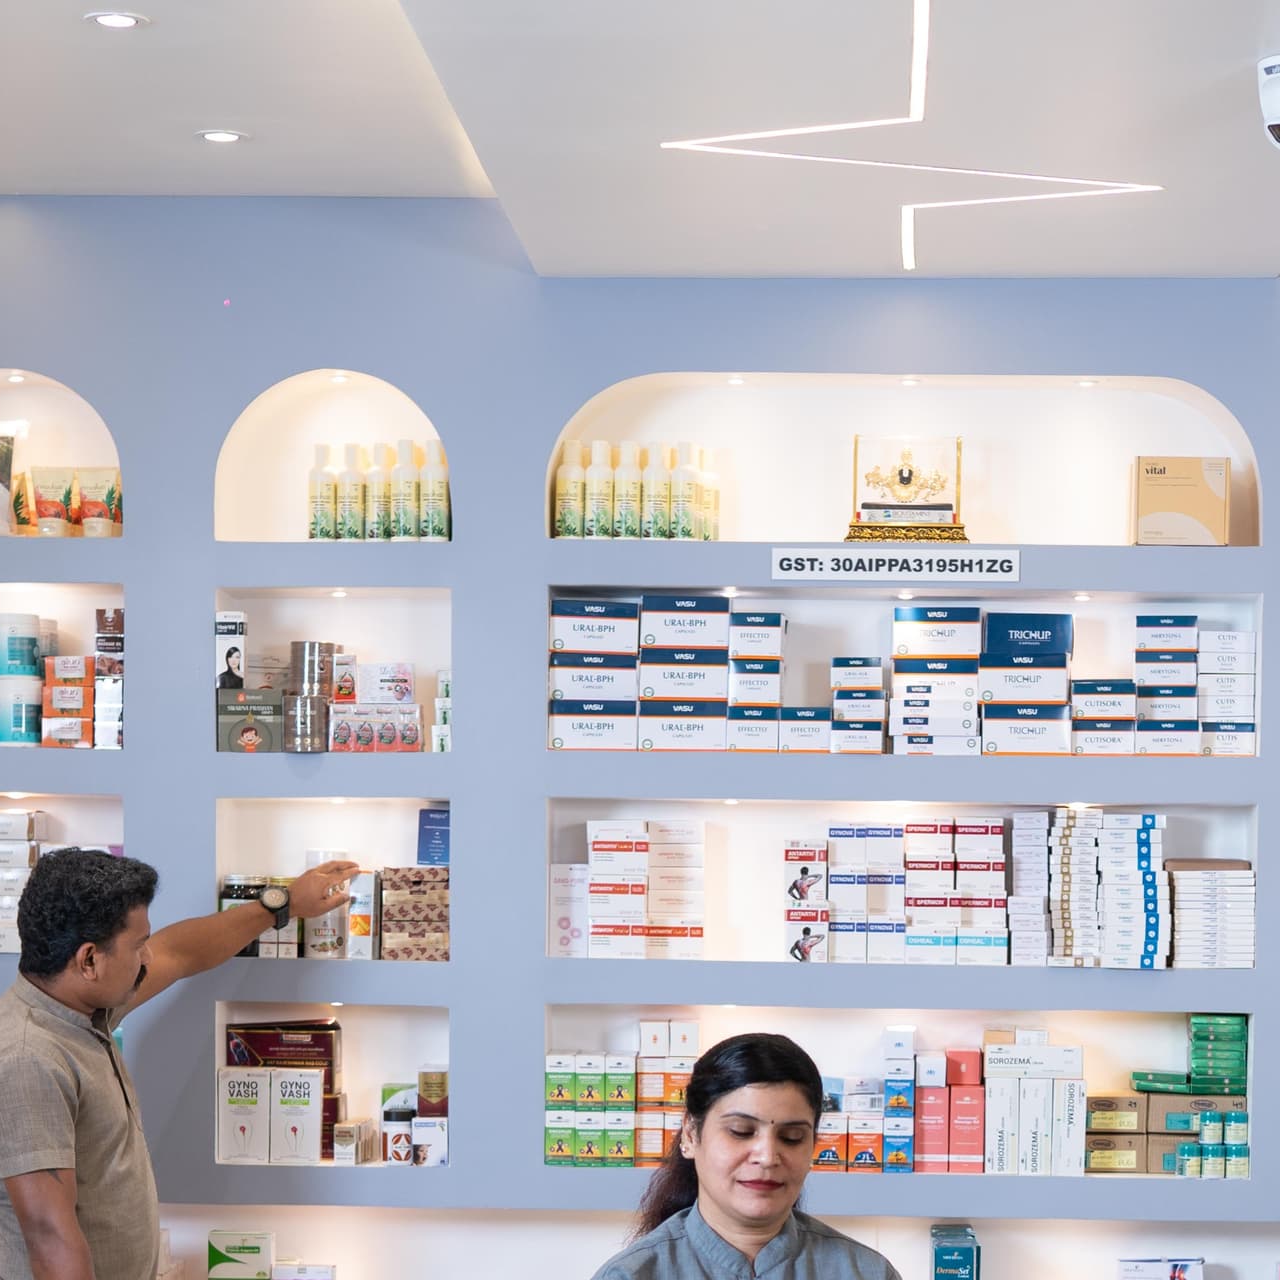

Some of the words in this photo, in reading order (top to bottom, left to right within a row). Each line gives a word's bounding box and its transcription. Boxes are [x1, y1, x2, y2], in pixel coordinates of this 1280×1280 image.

[1145, 466, 1166, 475] vital
[779, 557, 824, 572] GST:
[830, 558, 1014, 573] 30AIPPA3195H1ZG
[664, 619, 706, 628] URAL-BPH
[572, 624, 616, 633] URAL-BPH
[1008, 630, 1051, 640] TRICHUP
[927, 662, 947, 670] VASU
[572, 674, 614, 683] URAL-BPH
[663, 671, 705, 680] URAL-BPH
[1004, 675, 1042, 683] TRICHUP
[572, 722, 614, 731] URAL-BPH
[661, 723, 704, 732] URAL-BPH
[1008, 726, 1047, 735] TRICHUP
[988, 1056, 1031, 1065] SOROZEMA
[228, 1080, 258, 1090] GYNO
[280, 1081, 311, 1090] GYNO
[228, 1089, 258, 1098] VASH
[280, 1089, 311, 1098] VASH
[1067, 1082, 1075, 1126] SOROZEMA
[997, 1129, 1005, 1172] SOROZEMA
[1031, 1130, 1039, 1173] SOROZEMA
